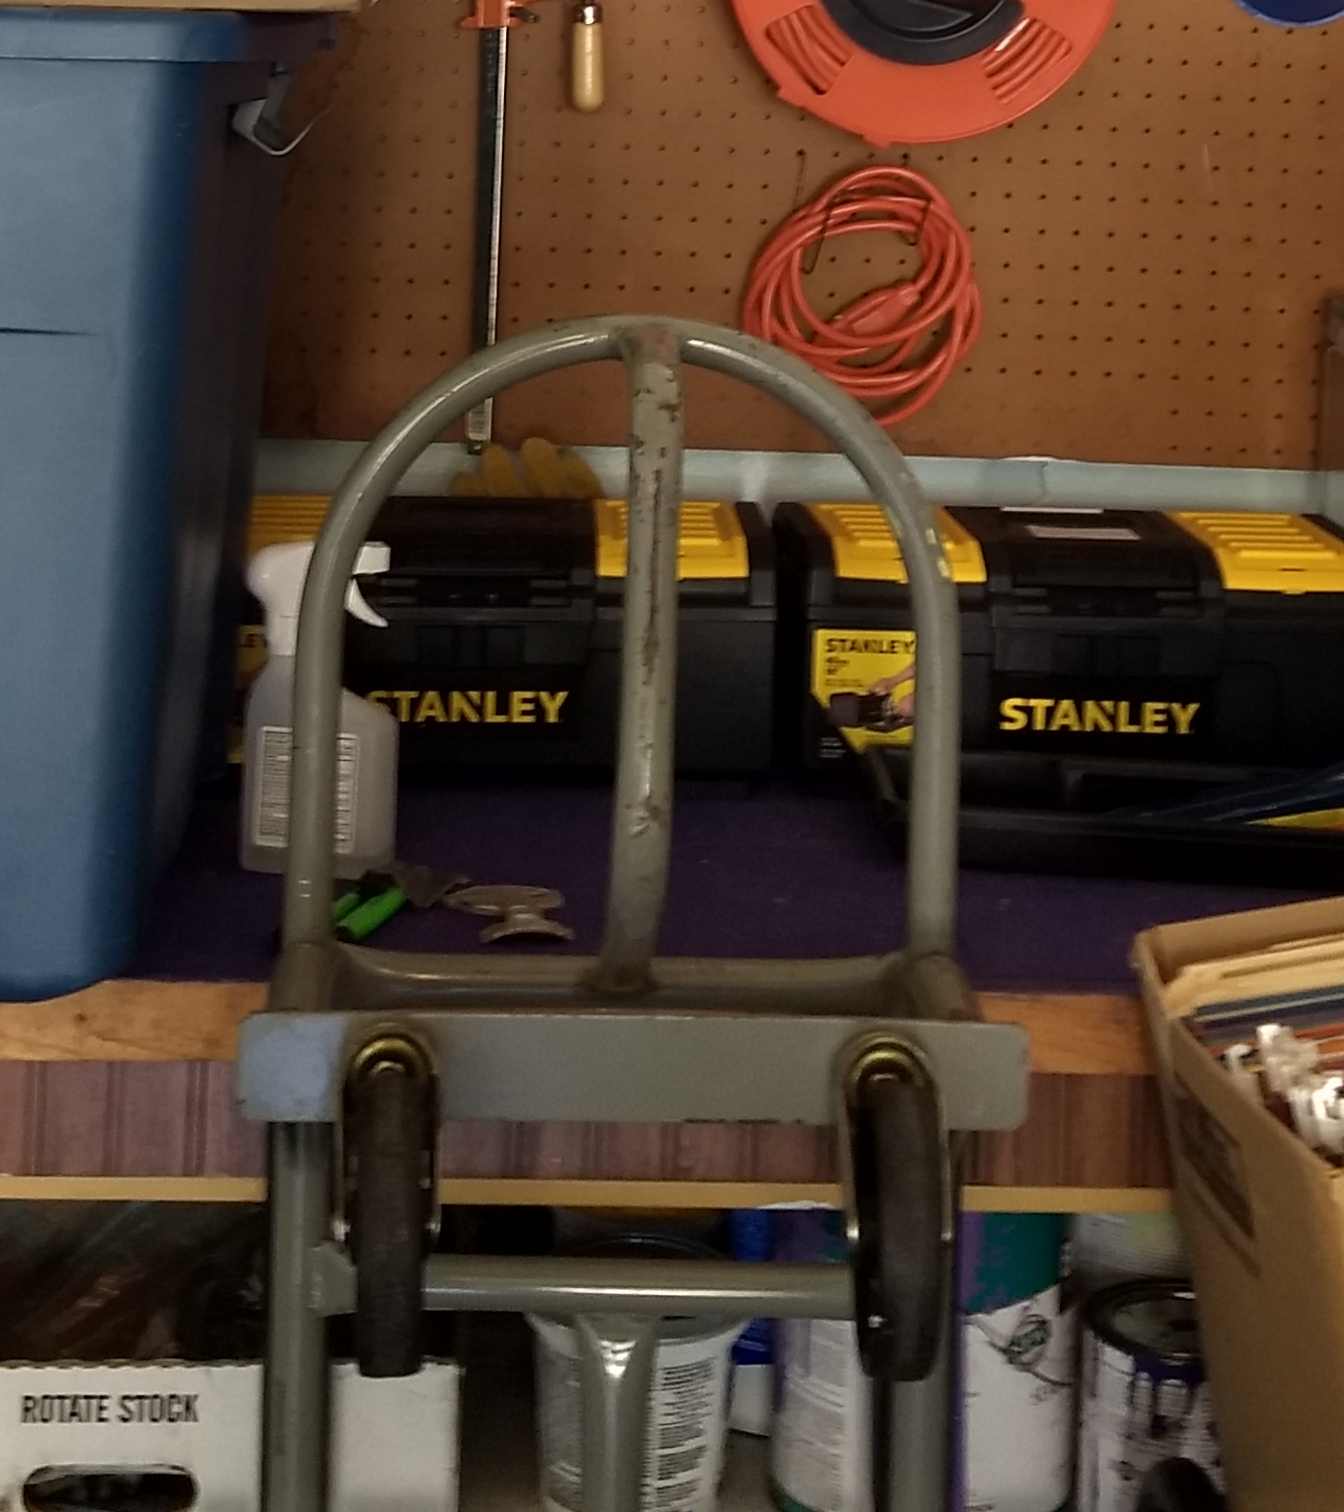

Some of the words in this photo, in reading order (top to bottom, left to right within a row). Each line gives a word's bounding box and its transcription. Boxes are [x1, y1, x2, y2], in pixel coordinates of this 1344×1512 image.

[825, 637, 915, 655] STANLEY
[999, 696, 1201, 736] STANLEY
[21, 1393, 110, 1423] ROTATE
[116, 1393, 199, 1423] STOCK
